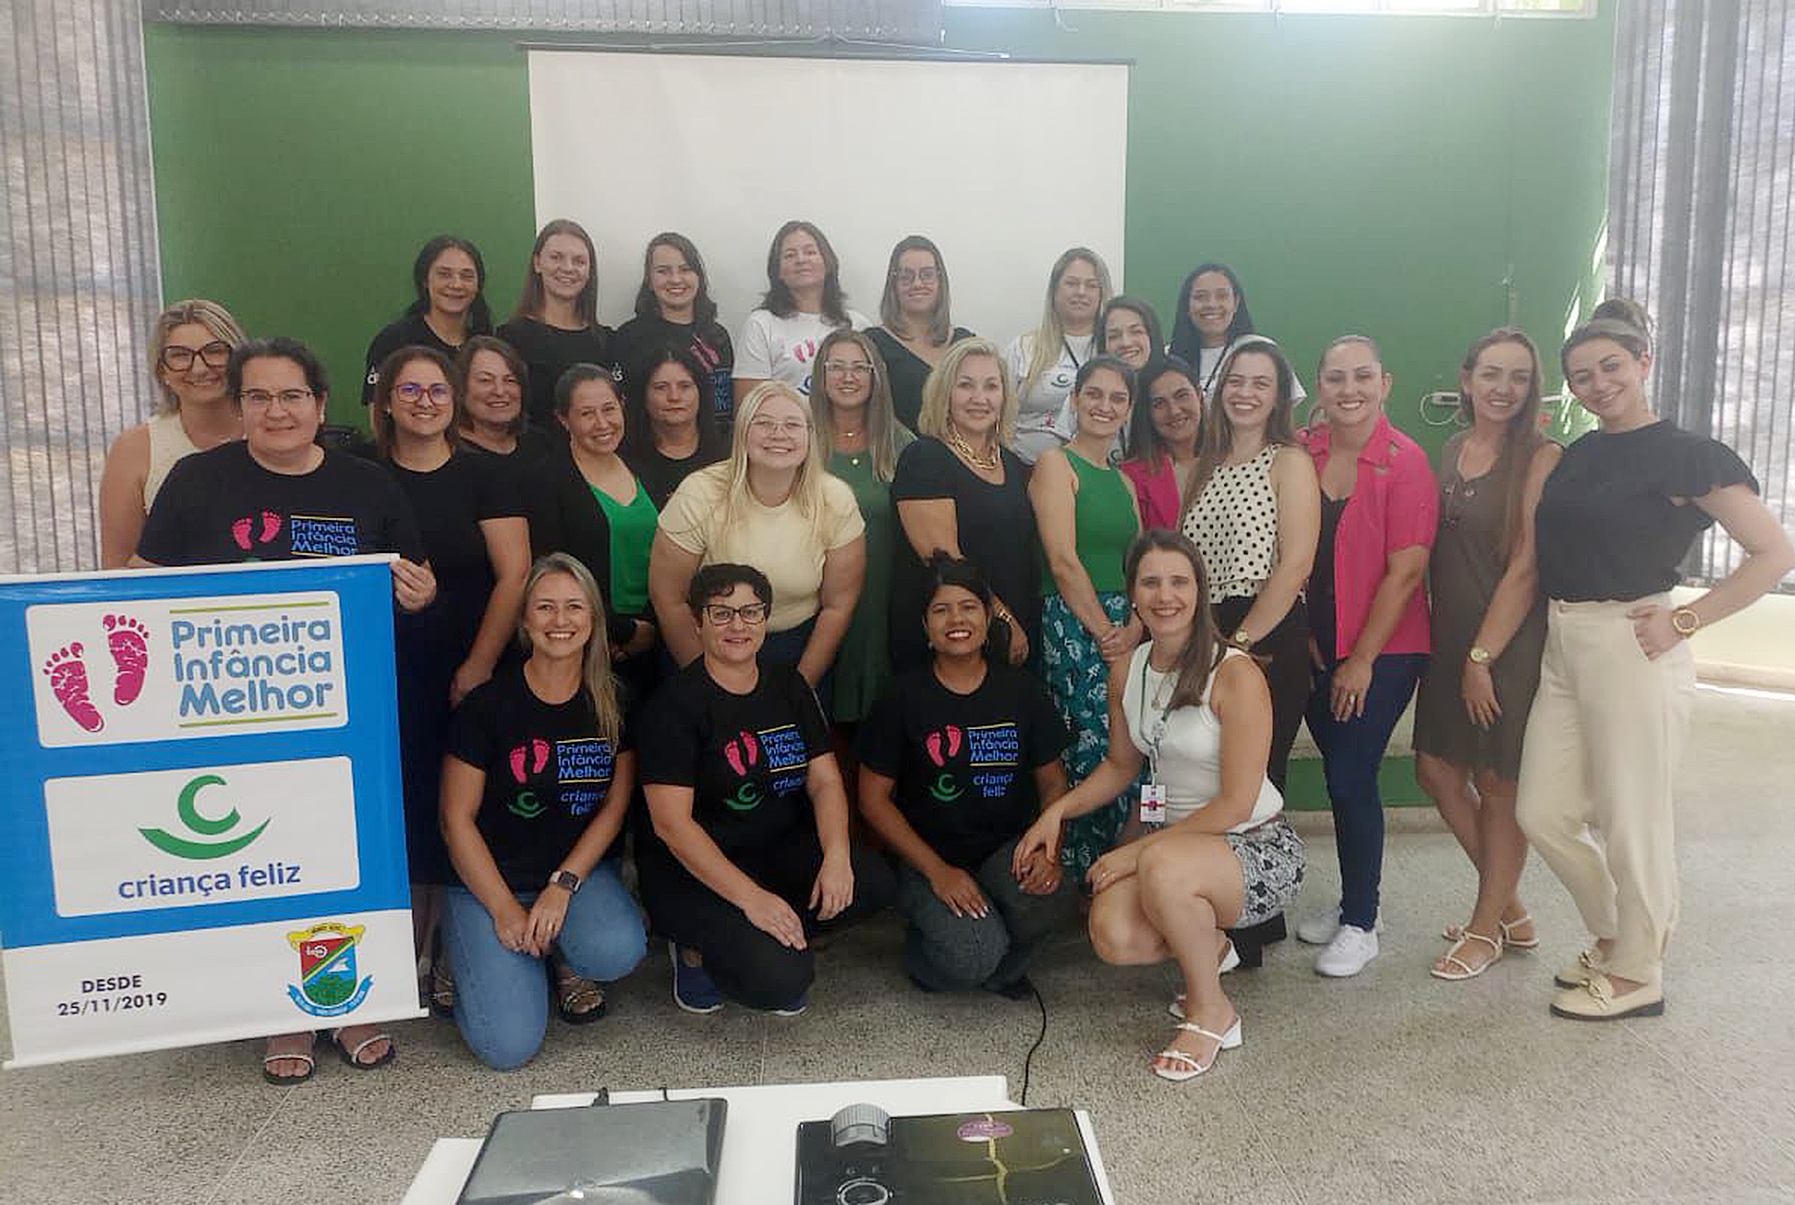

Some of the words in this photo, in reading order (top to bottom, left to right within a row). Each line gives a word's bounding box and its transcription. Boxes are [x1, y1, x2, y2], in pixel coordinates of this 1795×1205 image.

[291, 520, 355, 534] Primeira
[291, 531, 356, 546] Infância
[291, 541, 358, 556] Melhor
[171, 615, 332, 649] Primeira
[174, 645, 332, 682] Infância
[179, 679, 333, 717] Melhor
[969, 729, 1017, 740] Primeira
[969, 740, 1018, 750] Infância
[969, 750, 1018, 762] Melhor
[558, 766, 612, 779] Melhor
[118, 871, 231, 900] criança
[238, 862, 301, 890] feliz
[82, 975, 142, 994] DESDE
[58, 992, 167, 1017] 25/11/2019
